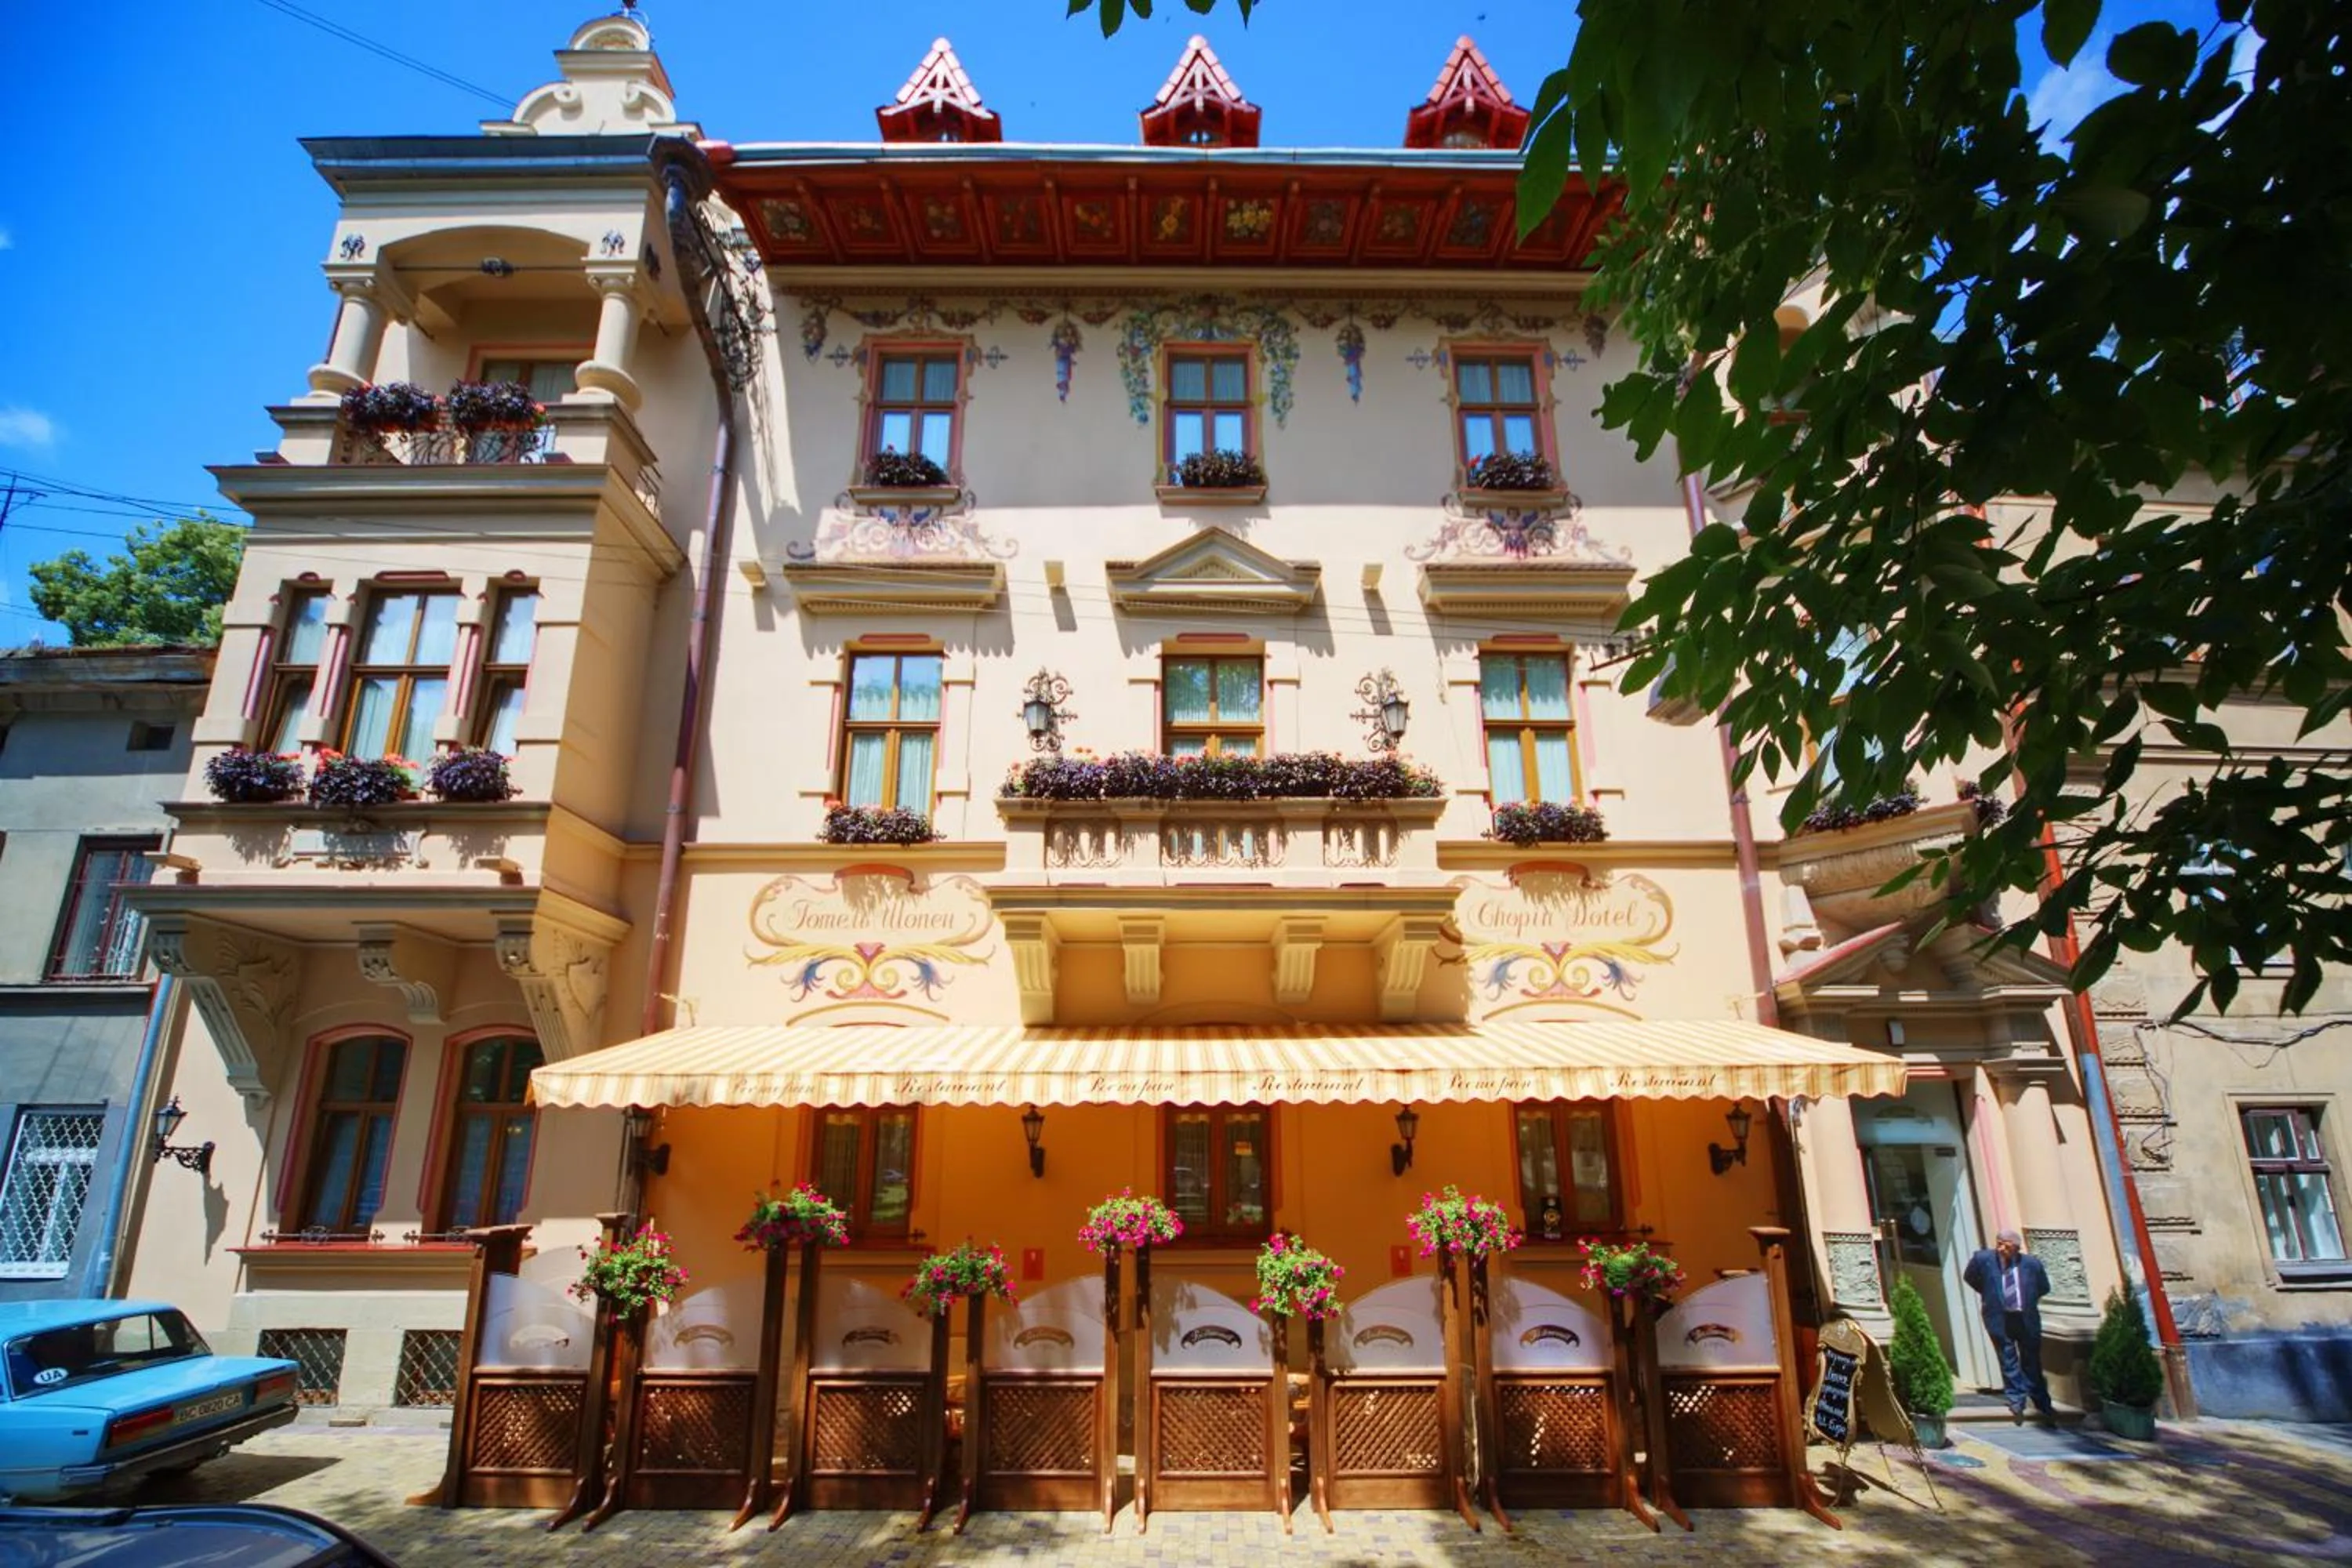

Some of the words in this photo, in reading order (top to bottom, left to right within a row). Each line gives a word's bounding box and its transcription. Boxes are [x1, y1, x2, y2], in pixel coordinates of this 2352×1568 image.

[1474, 902, 1553, 937] Chopin
[1570, 902, 1639, 927] Hotel
[894, 1076, 1007, 1093] Restaurant
[1252, 1075, 1364, 1091] Restaurant
[1610, 1072, 1716, 1087] Restaurant
[40, 1370, 63, 1382] UA
